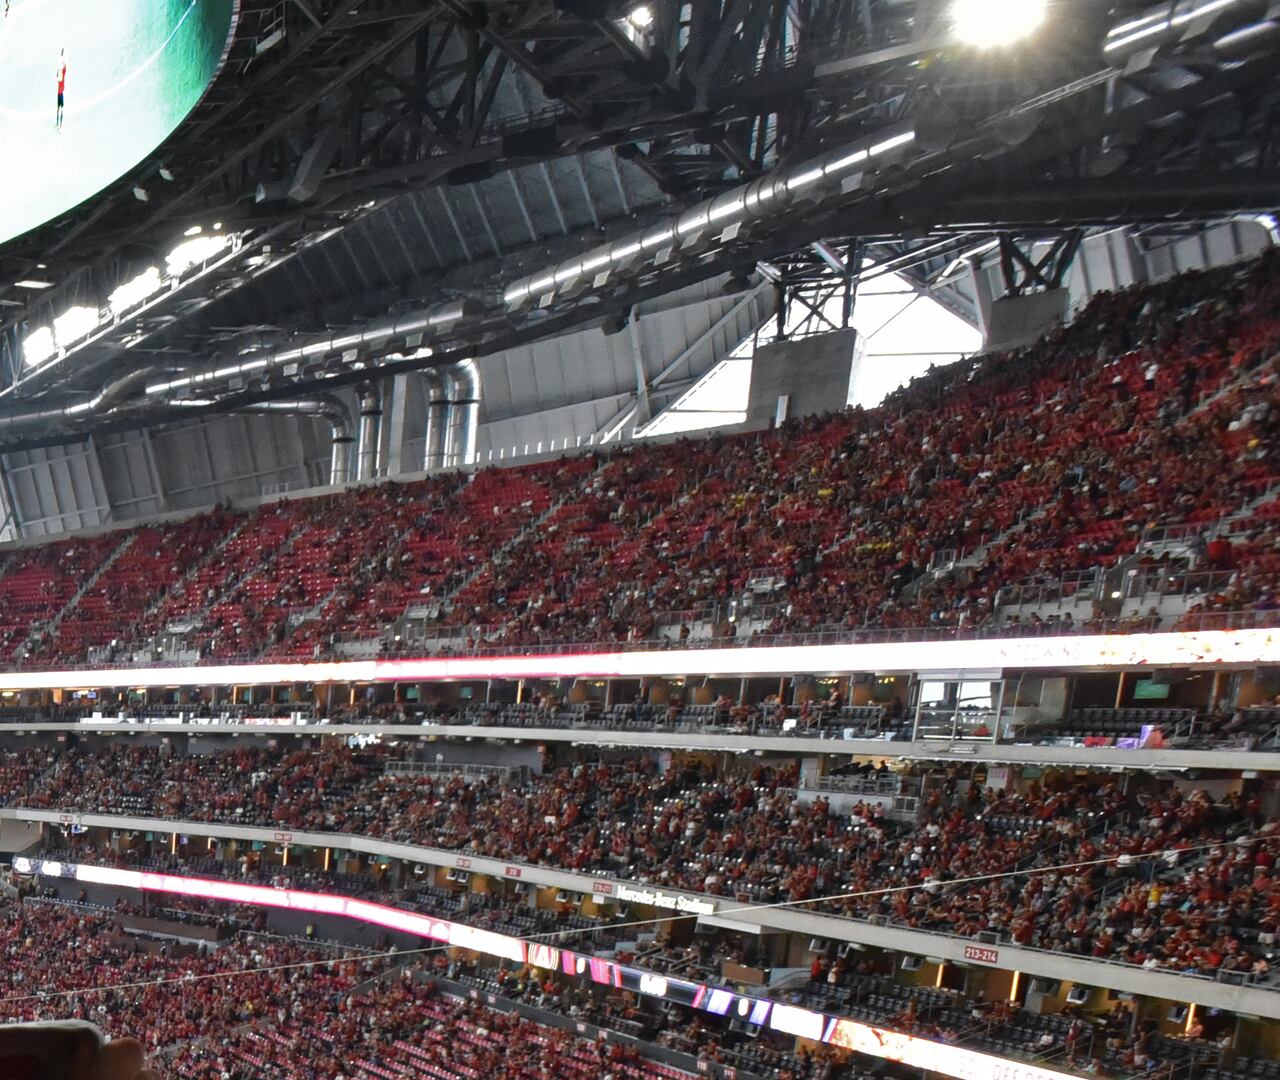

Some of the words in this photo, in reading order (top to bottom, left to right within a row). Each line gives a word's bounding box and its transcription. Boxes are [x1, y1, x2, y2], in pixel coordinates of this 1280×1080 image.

[616, 884, 676, 908] Mercedes-Benz
[676, 894, 715, 915] Stadium
[965, 947, 998, 962] 213-214
